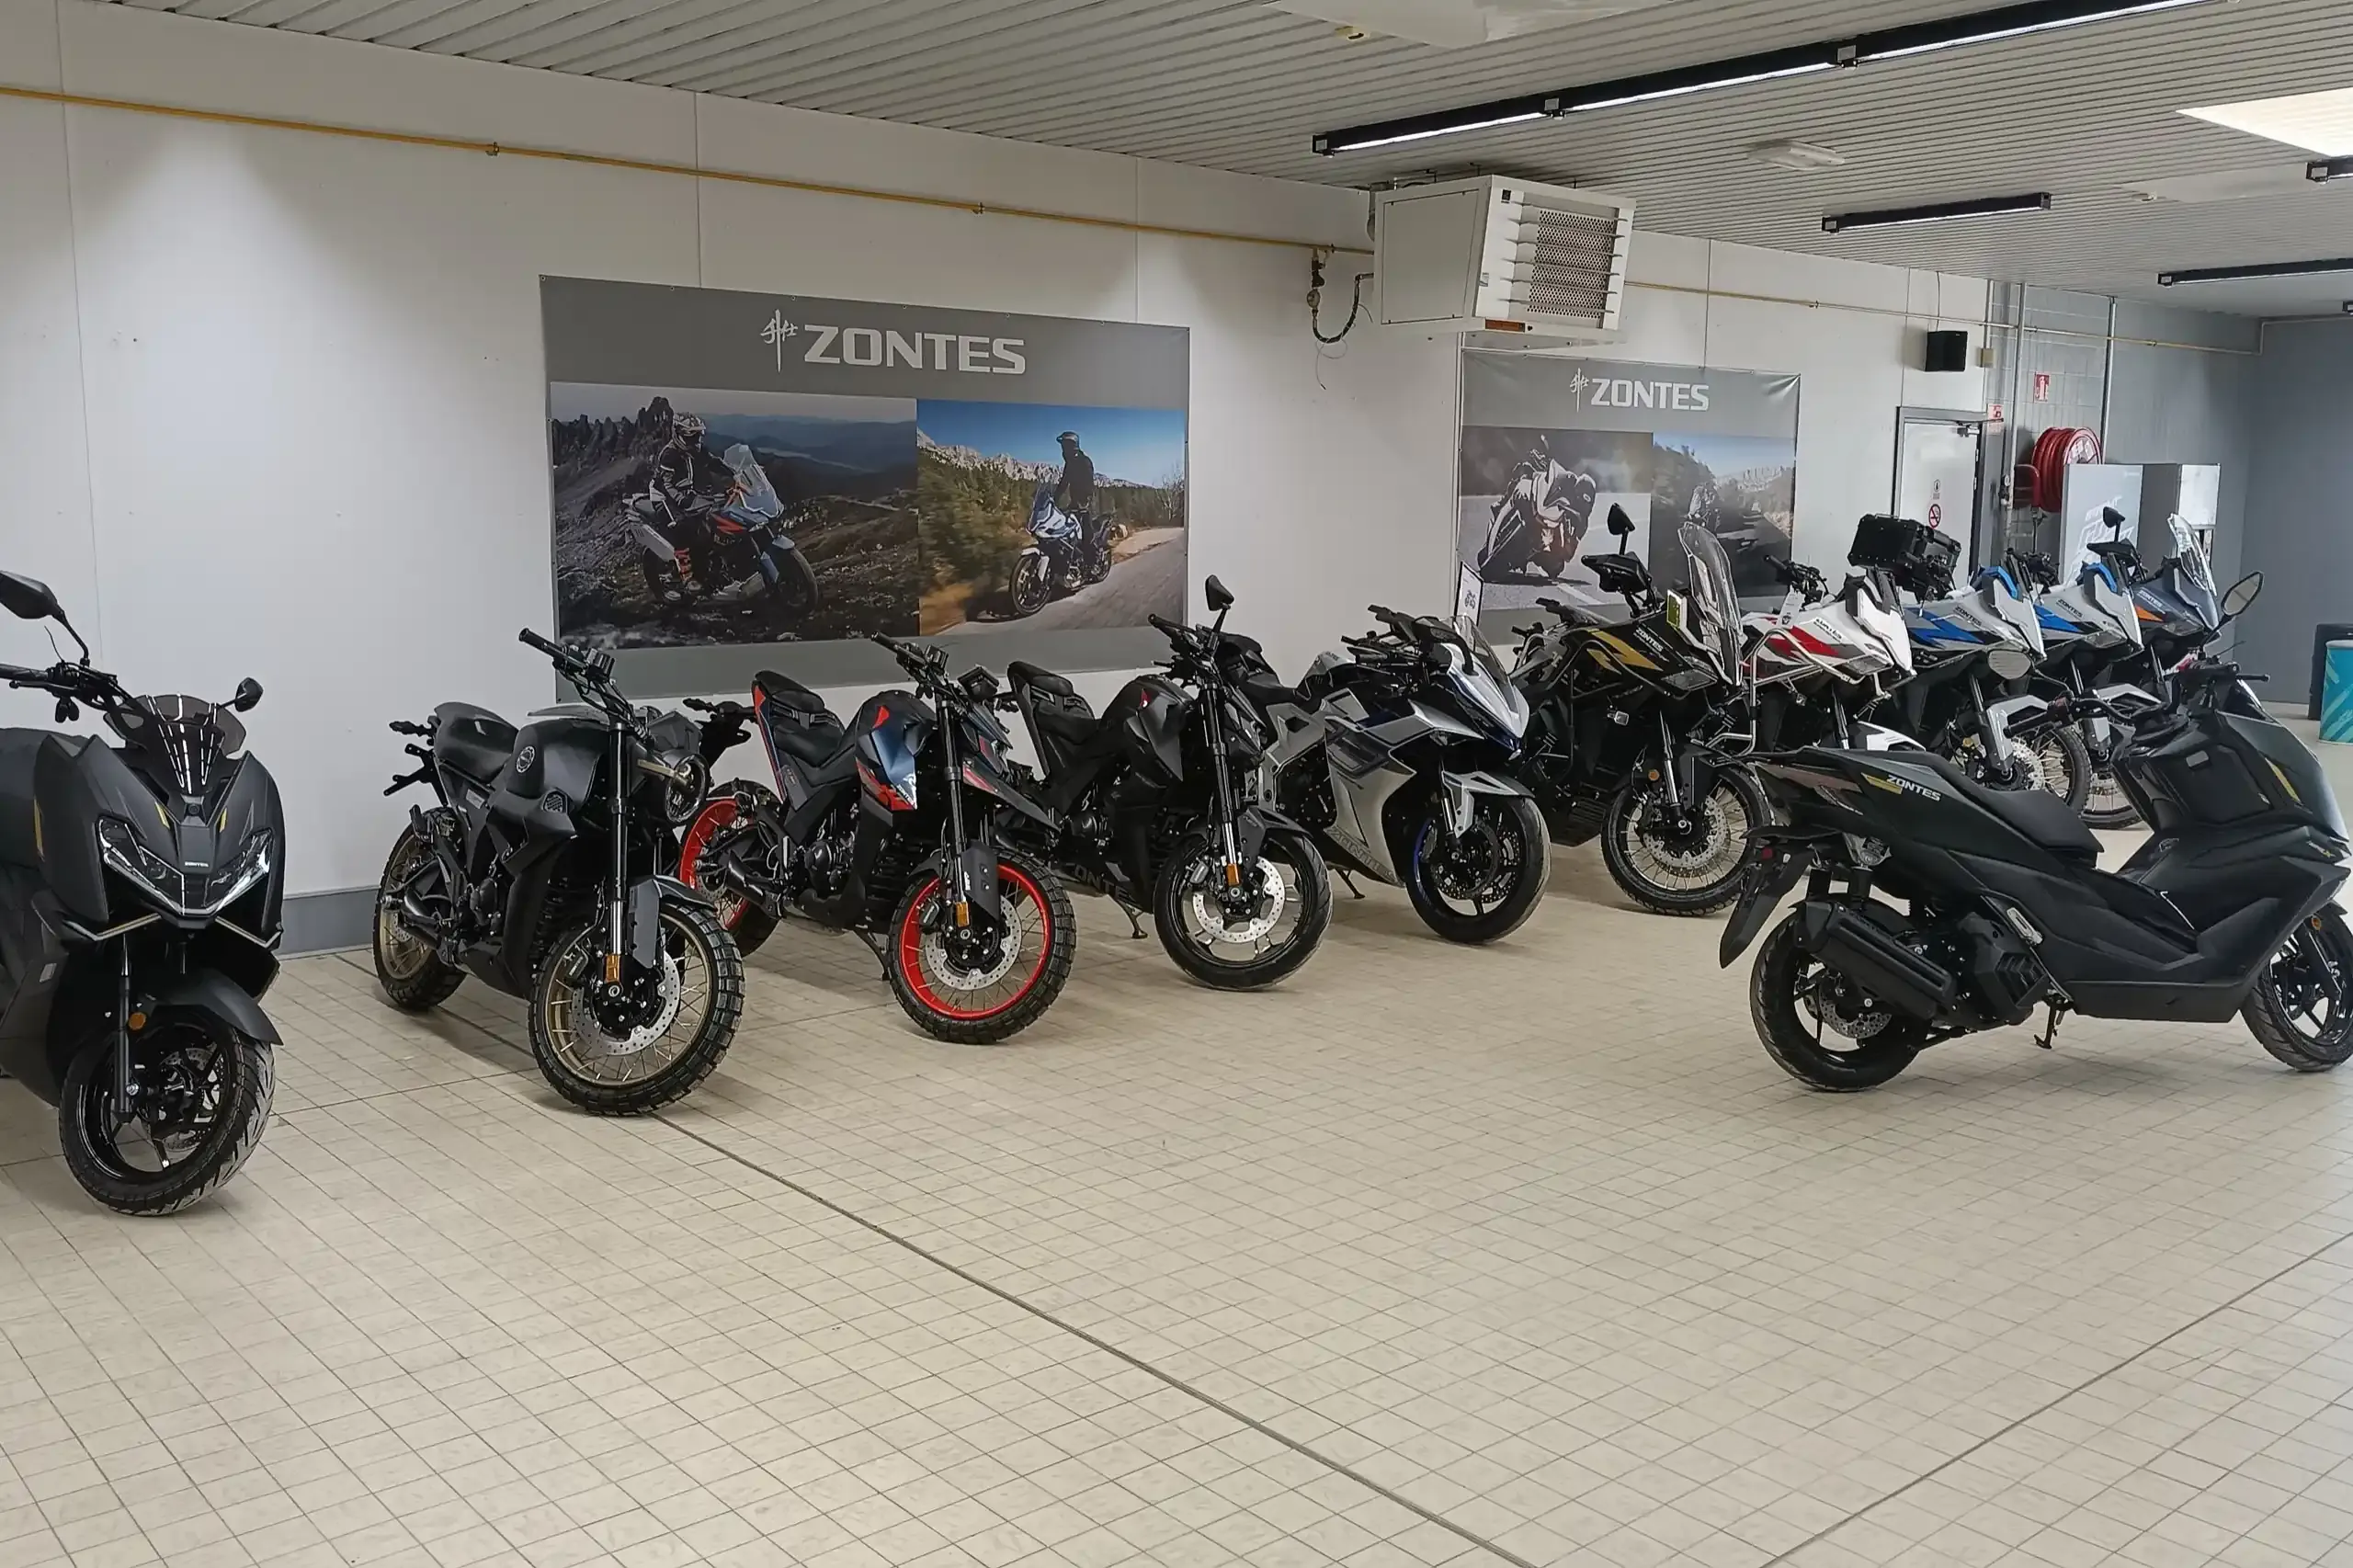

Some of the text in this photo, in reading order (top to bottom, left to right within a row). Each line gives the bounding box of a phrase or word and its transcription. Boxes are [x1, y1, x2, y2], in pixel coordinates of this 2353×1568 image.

[803, 324, 1027, 375] ZONTES
[1590, 378, 1711, 412] ZONTES
[1954, 605, 1983, 626] ZONTES
[2057, 598, 2084, 619] ZONTES
[1635, 626, 1665, 653] ZONTES
[1886, 773, 1942, 802] ZONTES
